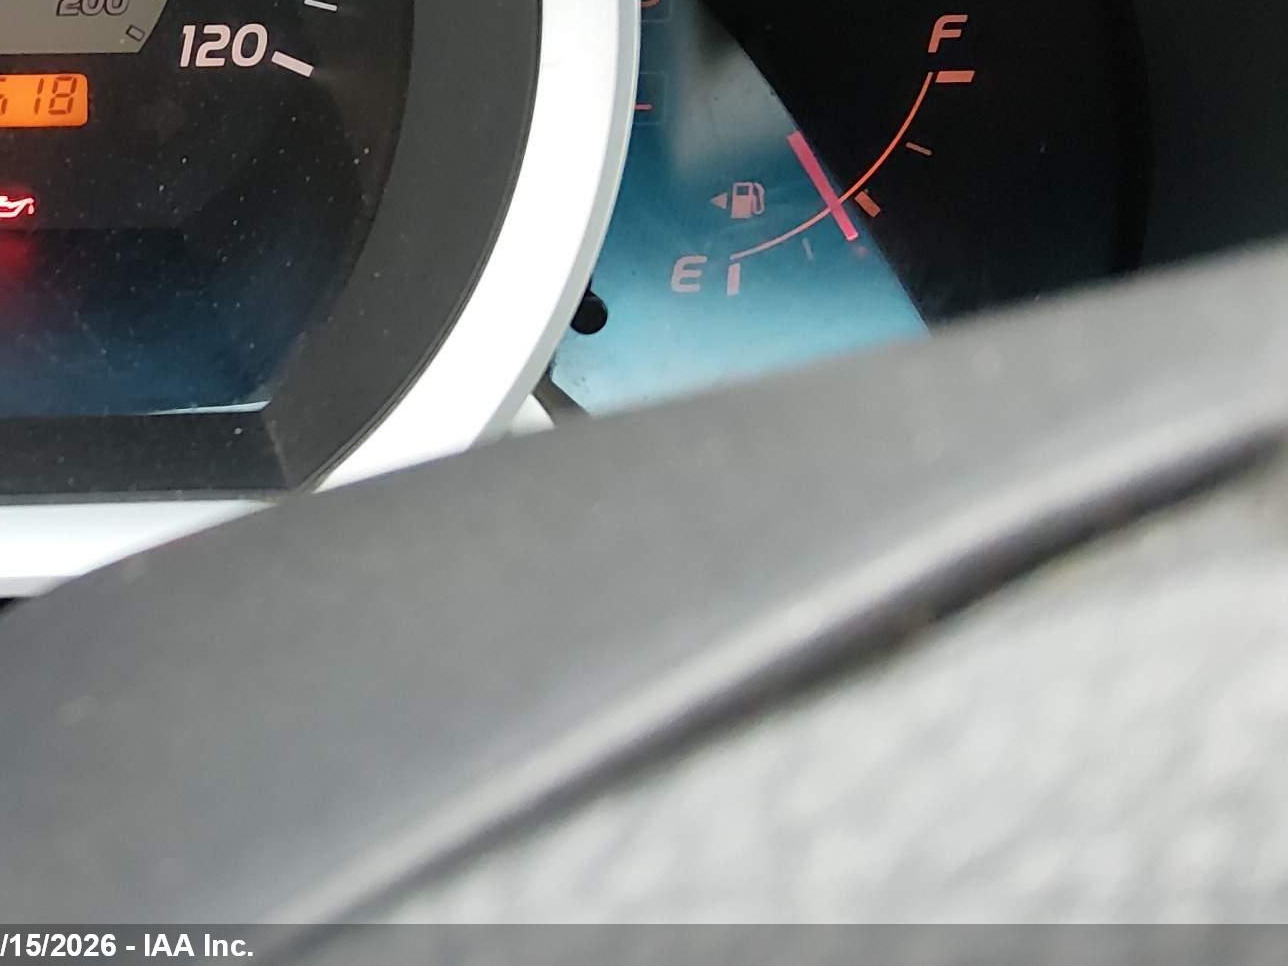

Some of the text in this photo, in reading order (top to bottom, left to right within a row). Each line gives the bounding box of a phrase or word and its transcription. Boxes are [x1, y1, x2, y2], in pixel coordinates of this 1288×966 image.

[179, 23, 267, 68] 120
[927, 14, 969, 53] F
[670, 255, 708, 293] E
